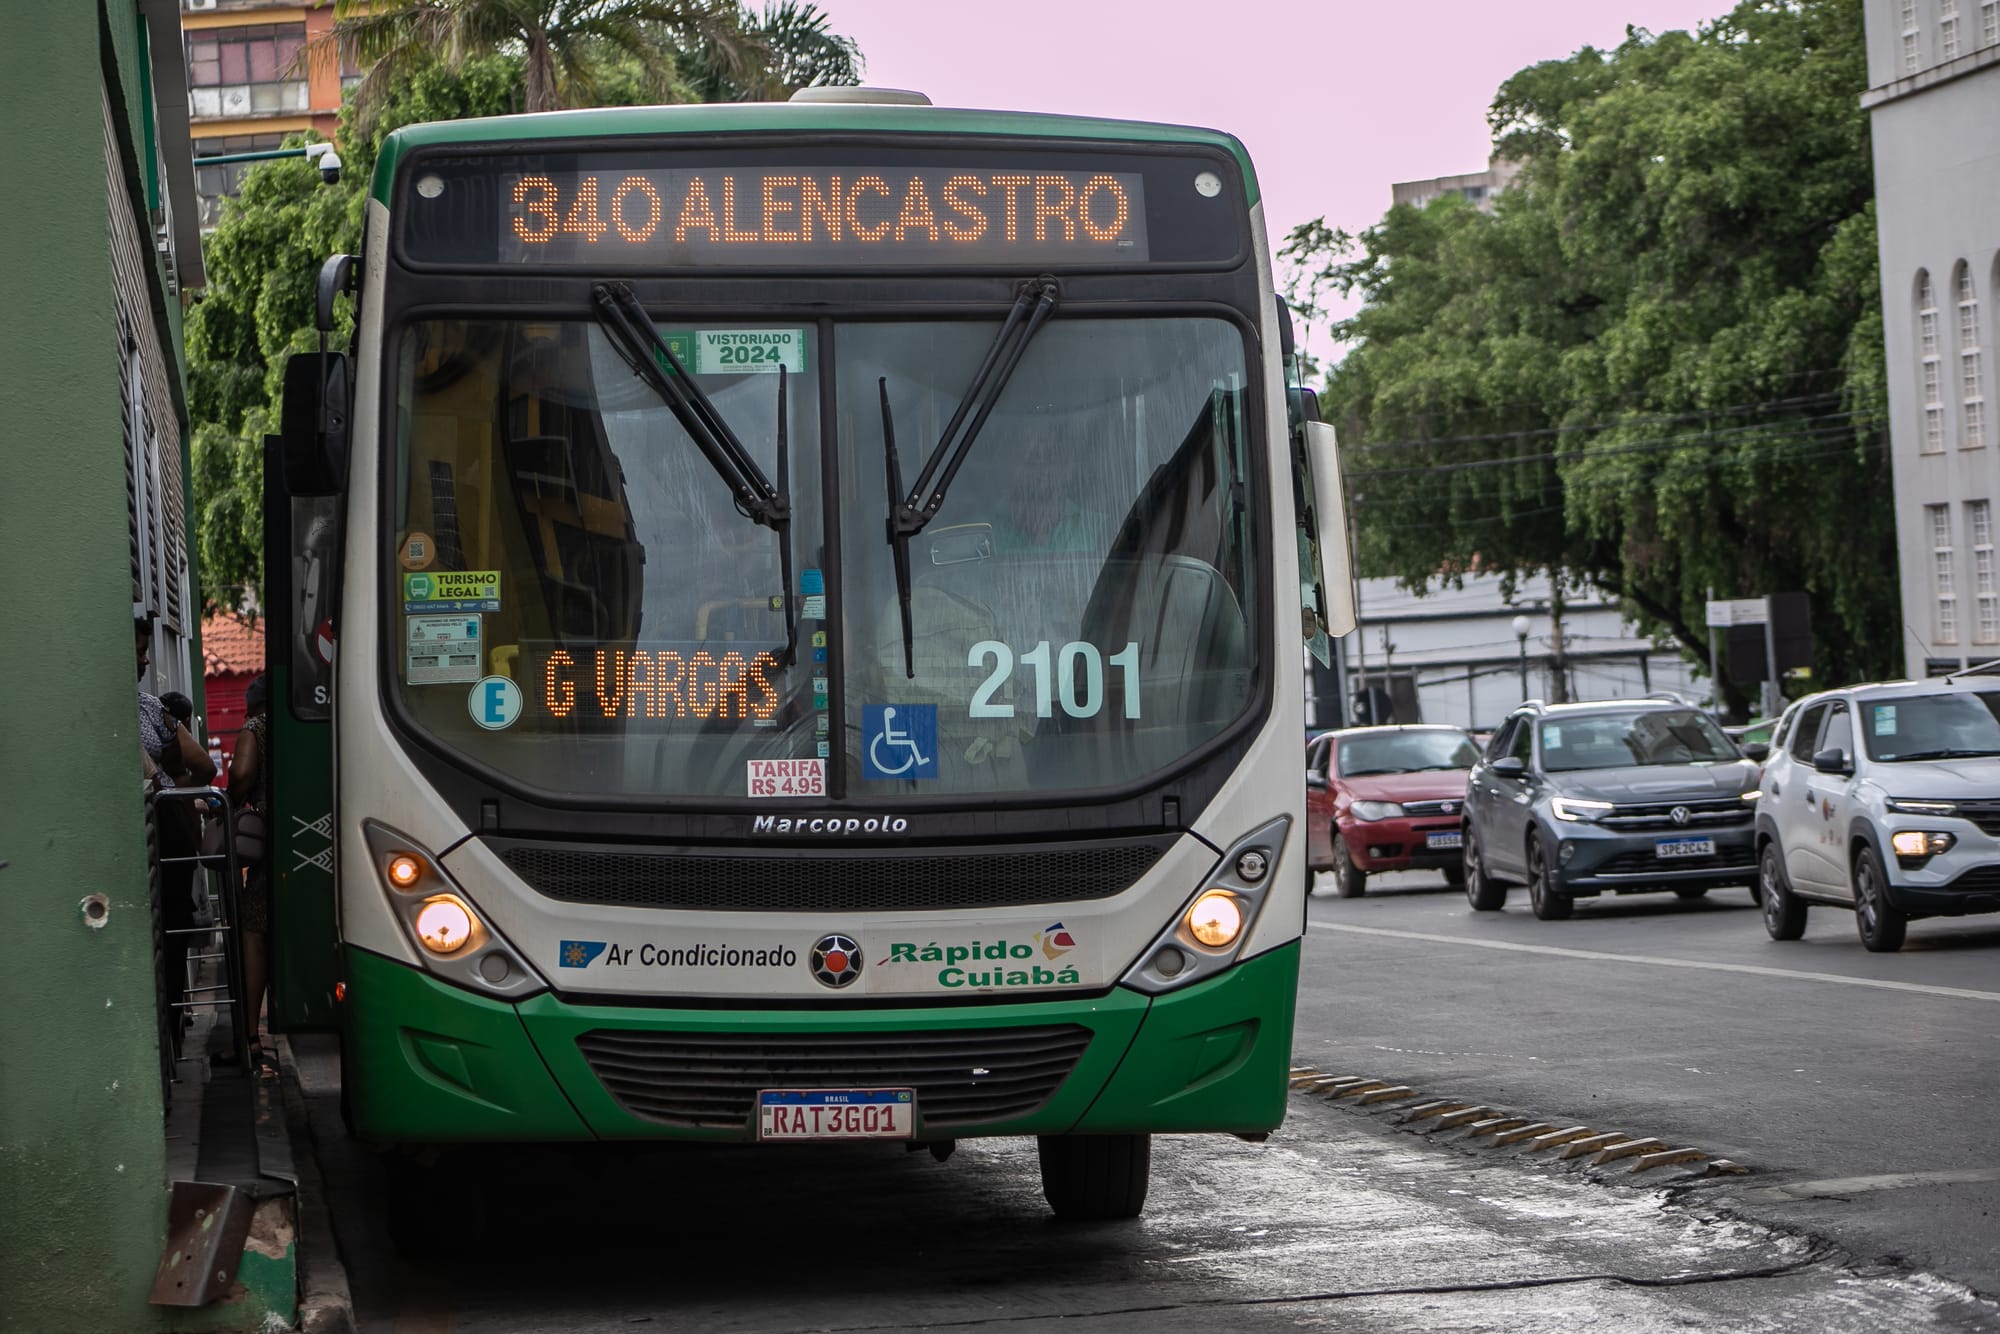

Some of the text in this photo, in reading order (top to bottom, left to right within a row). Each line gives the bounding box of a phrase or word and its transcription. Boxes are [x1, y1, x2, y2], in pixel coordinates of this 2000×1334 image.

[513, 175, 1128, 241] 340 ALENCASTRO
[707, 333, 791, 345] VISTORIADO
[719, 346, 781, 363] 2024
[438, 574, 497, 585] TURISMO
[439, 587, 481, 598] LEGAL
[546, 649, 778, 718] G VARGAS
[967, 640, 1141, 720] 2101
[485, 682, 505, 722] E
[751, 760, 822, 777] TARIFA
[752, 777, 822, 796] R$ 4,95
[752, 815, 908, 835] Marcopolo
[1662, 842, 1710, 856] SPE2C42
[605, 943, 796, 967] Ar Condicionado
[890, 940, 1033, 966] Rápido
[938, 964, 1080, 988] Cuiabá
[825, 1095, 849, 1103] BRASIL
[773, 1105, 896, 1133] RAT3G01
